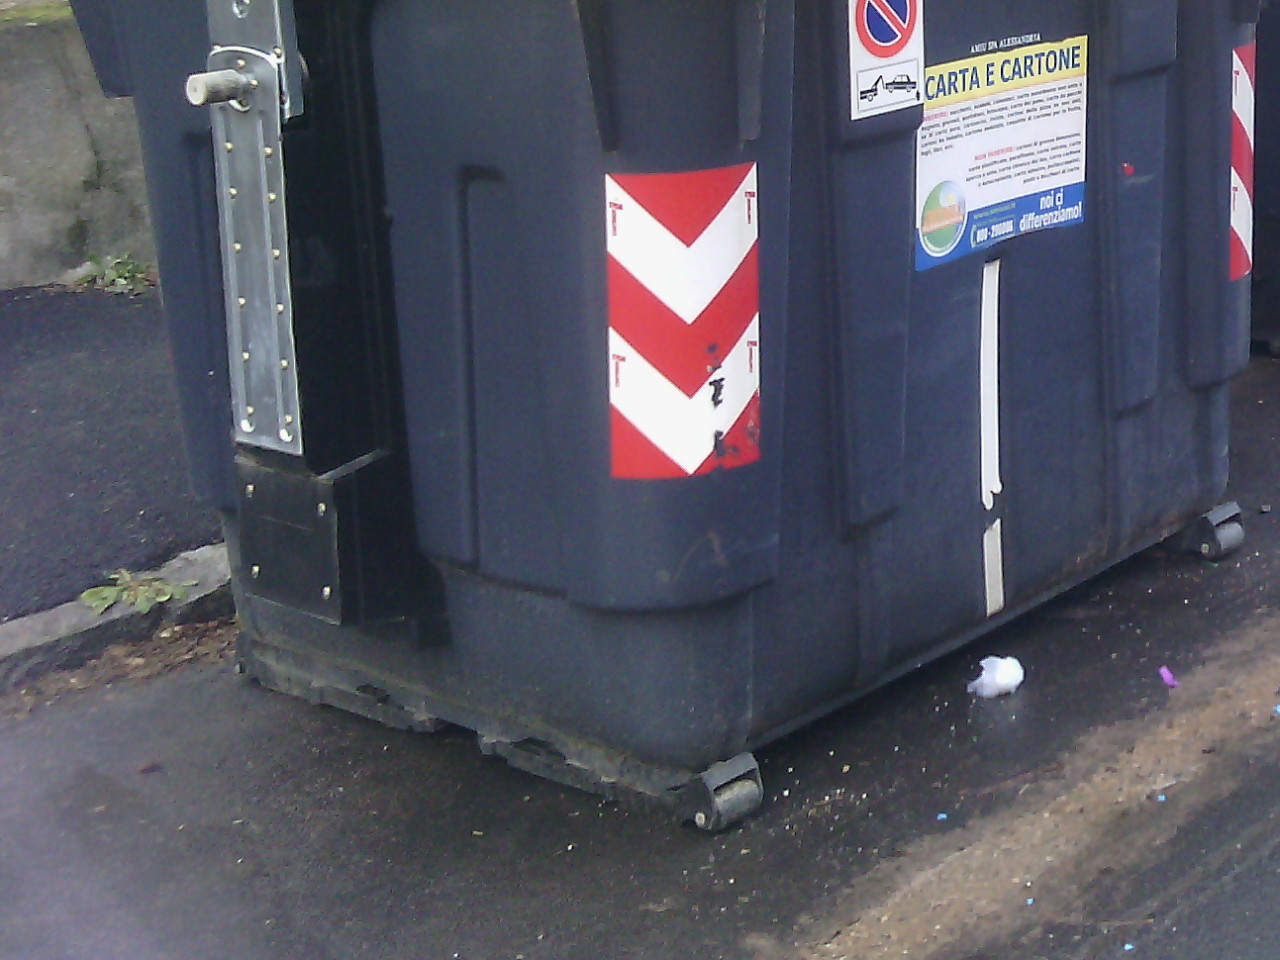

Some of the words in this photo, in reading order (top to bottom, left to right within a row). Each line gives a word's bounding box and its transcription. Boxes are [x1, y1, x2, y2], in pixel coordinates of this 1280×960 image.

[925, 67, 980, 101] CARTA
[986, 62, 996, 87] E
[1000, 45, 1081, 83] CARTONE
[1040, 190, 1054, 210] noi
[1055, 189, 1064, 206] ci
[1019, 200, 1082, 232] differenziamo!
